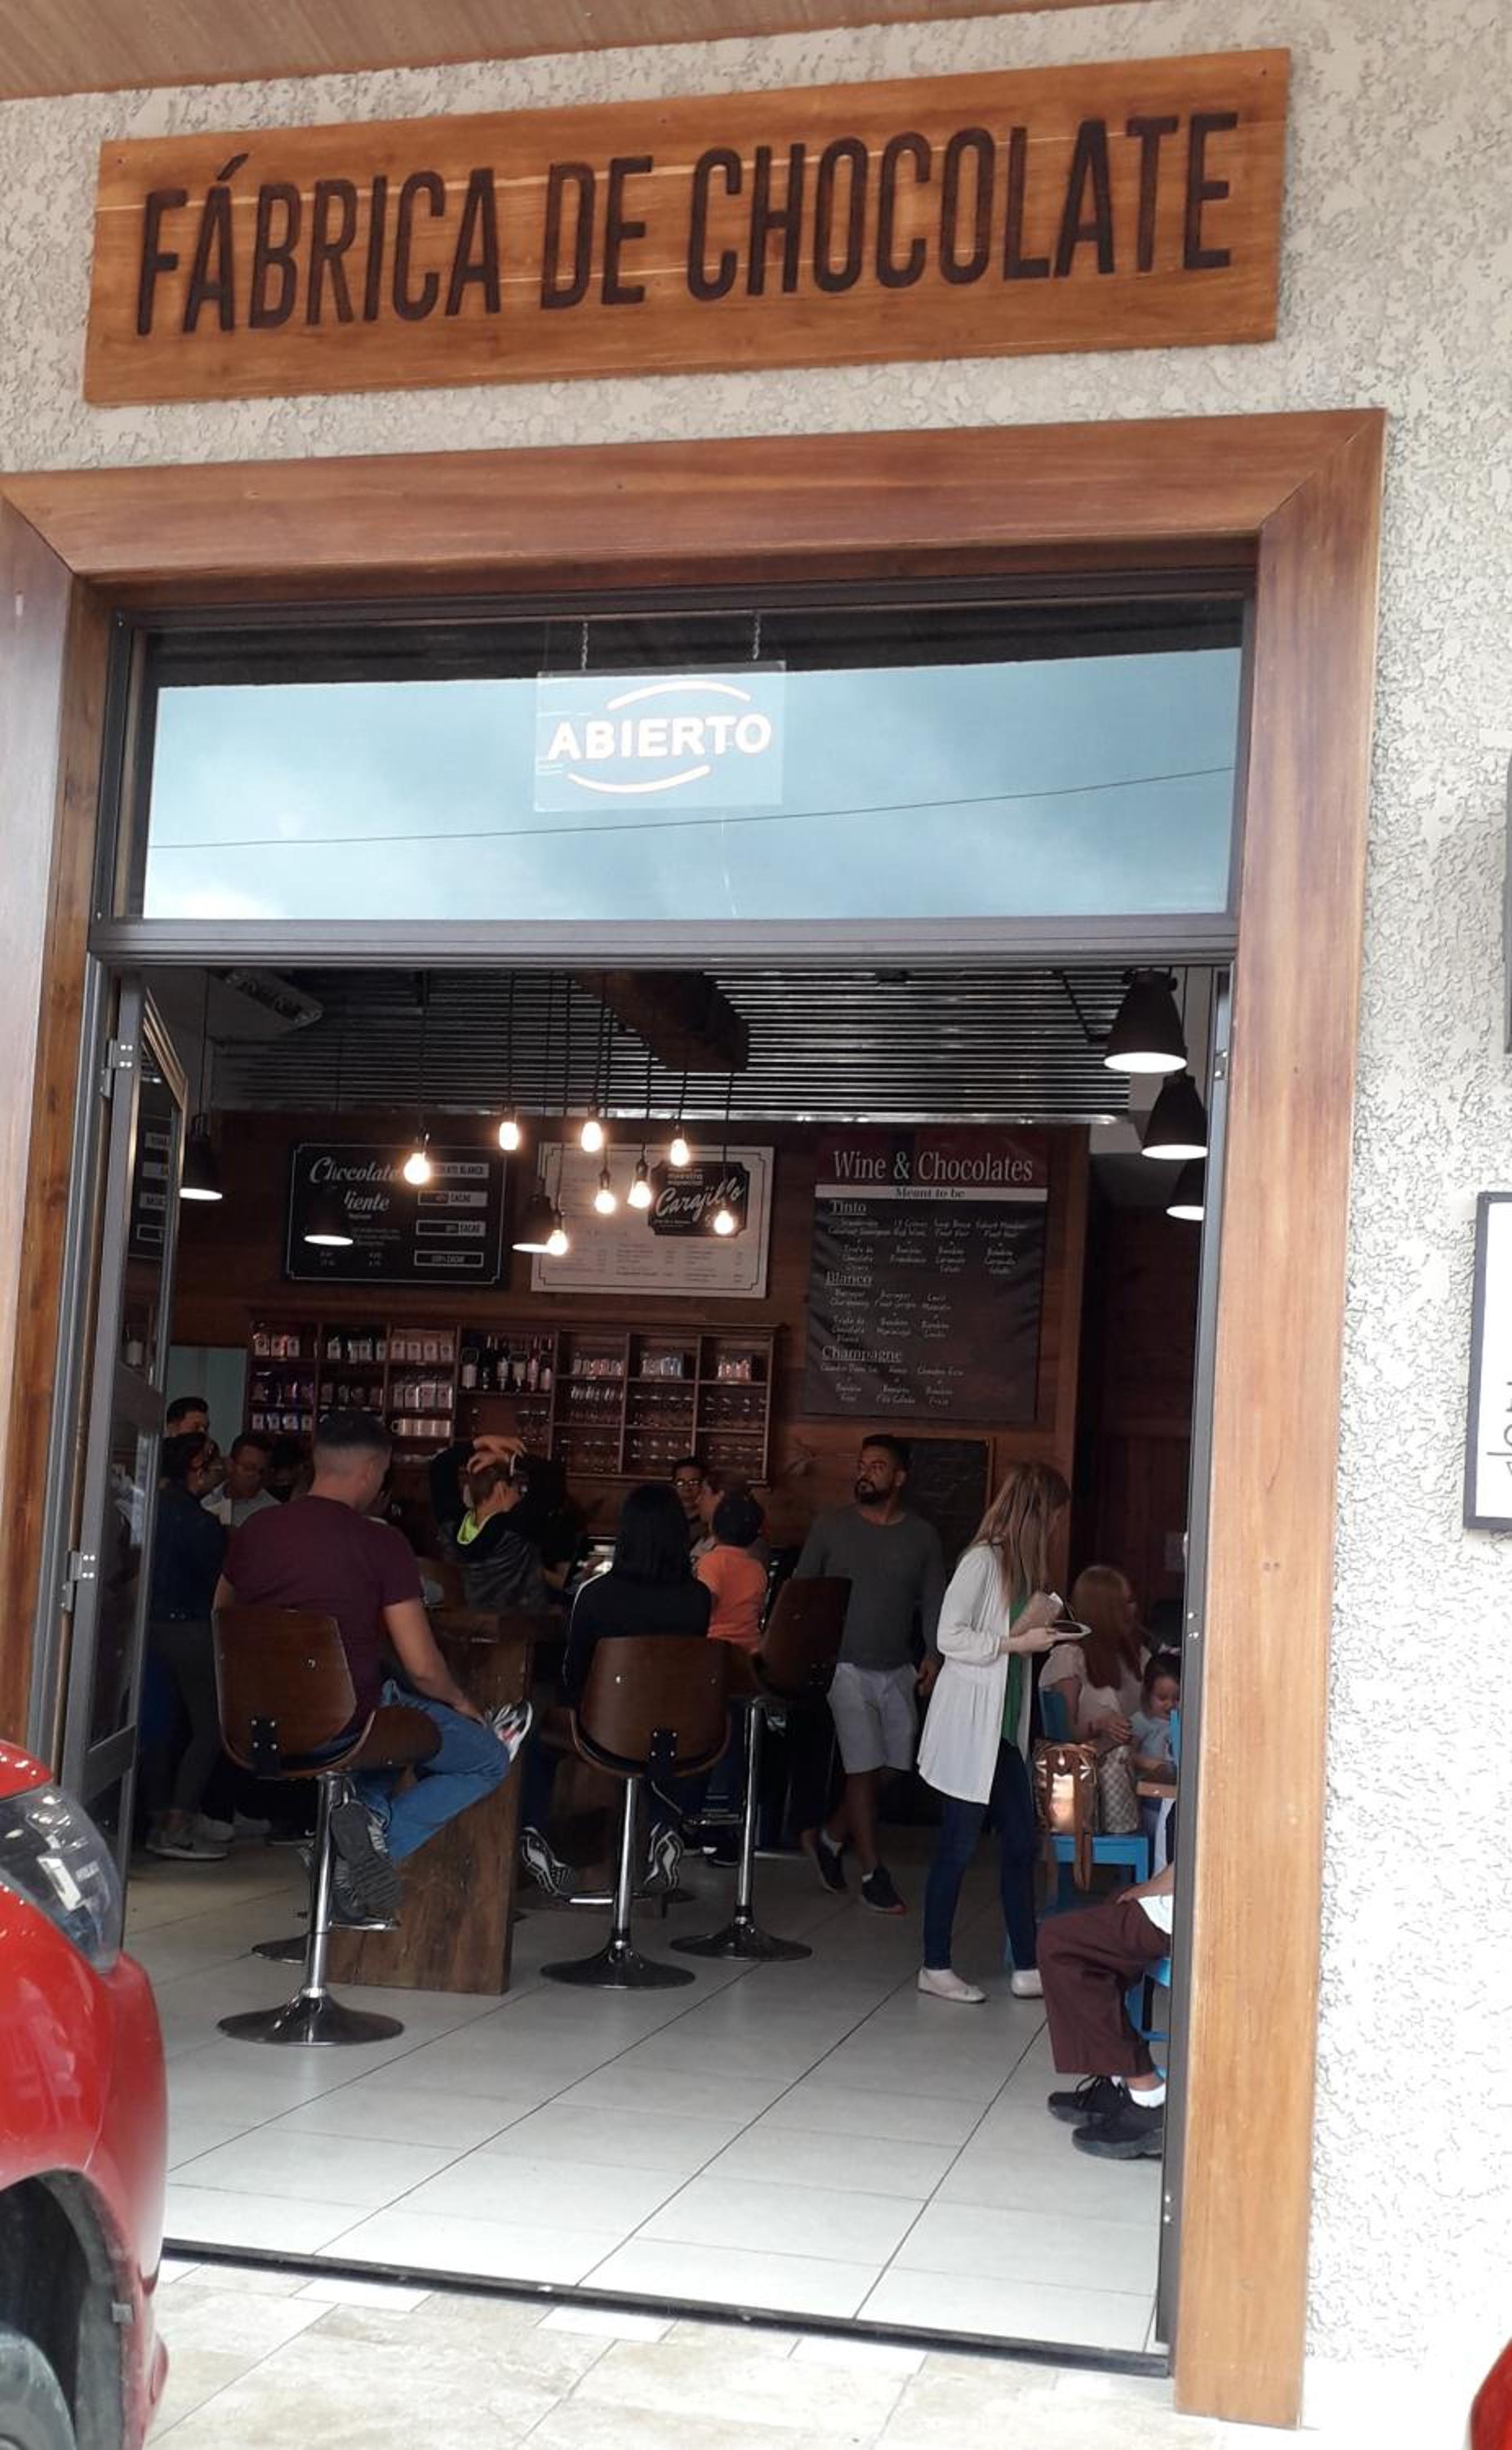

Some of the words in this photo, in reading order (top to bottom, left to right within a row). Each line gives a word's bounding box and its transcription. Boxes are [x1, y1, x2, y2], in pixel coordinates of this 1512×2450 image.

[137, 153, 500, 336] FÁBRICA
[540, 155, 653, 309] DE
[687, 111, 1239, 301] CHOCOLATE
[548, 713, 772, 760] ABIERTO
[833, 1150, 886, 1179] Wine
[892, 1150, 912, 1180] &
[918, 1150, 1034, 1182] Chocolates
[935, 1188, 948, 1198] to
[950, 1189, 966, 1199] be
[830, 1201, 868, 1214] Tinto
[825, 1271, 872, 1285] Blanco
[822, 1346, 902, 1362] Champagne
